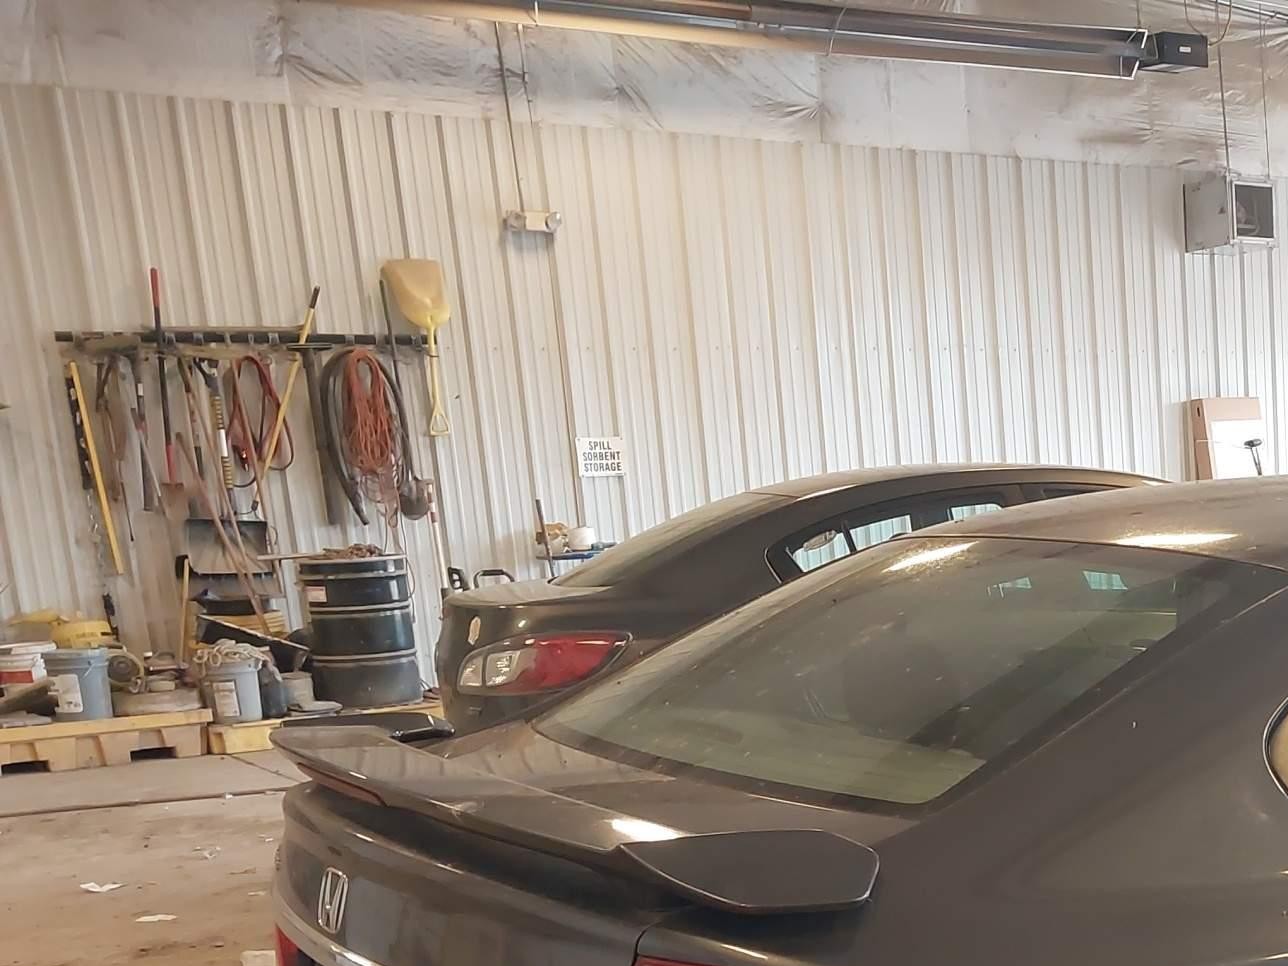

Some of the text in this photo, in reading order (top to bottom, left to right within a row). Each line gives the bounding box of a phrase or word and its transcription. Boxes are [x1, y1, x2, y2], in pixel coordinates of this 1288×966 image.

[588, 440, 612, 451] SPILL
[582, 451, 621, 462] SORBENT
[583, 461, 623, 473] STORAGE
